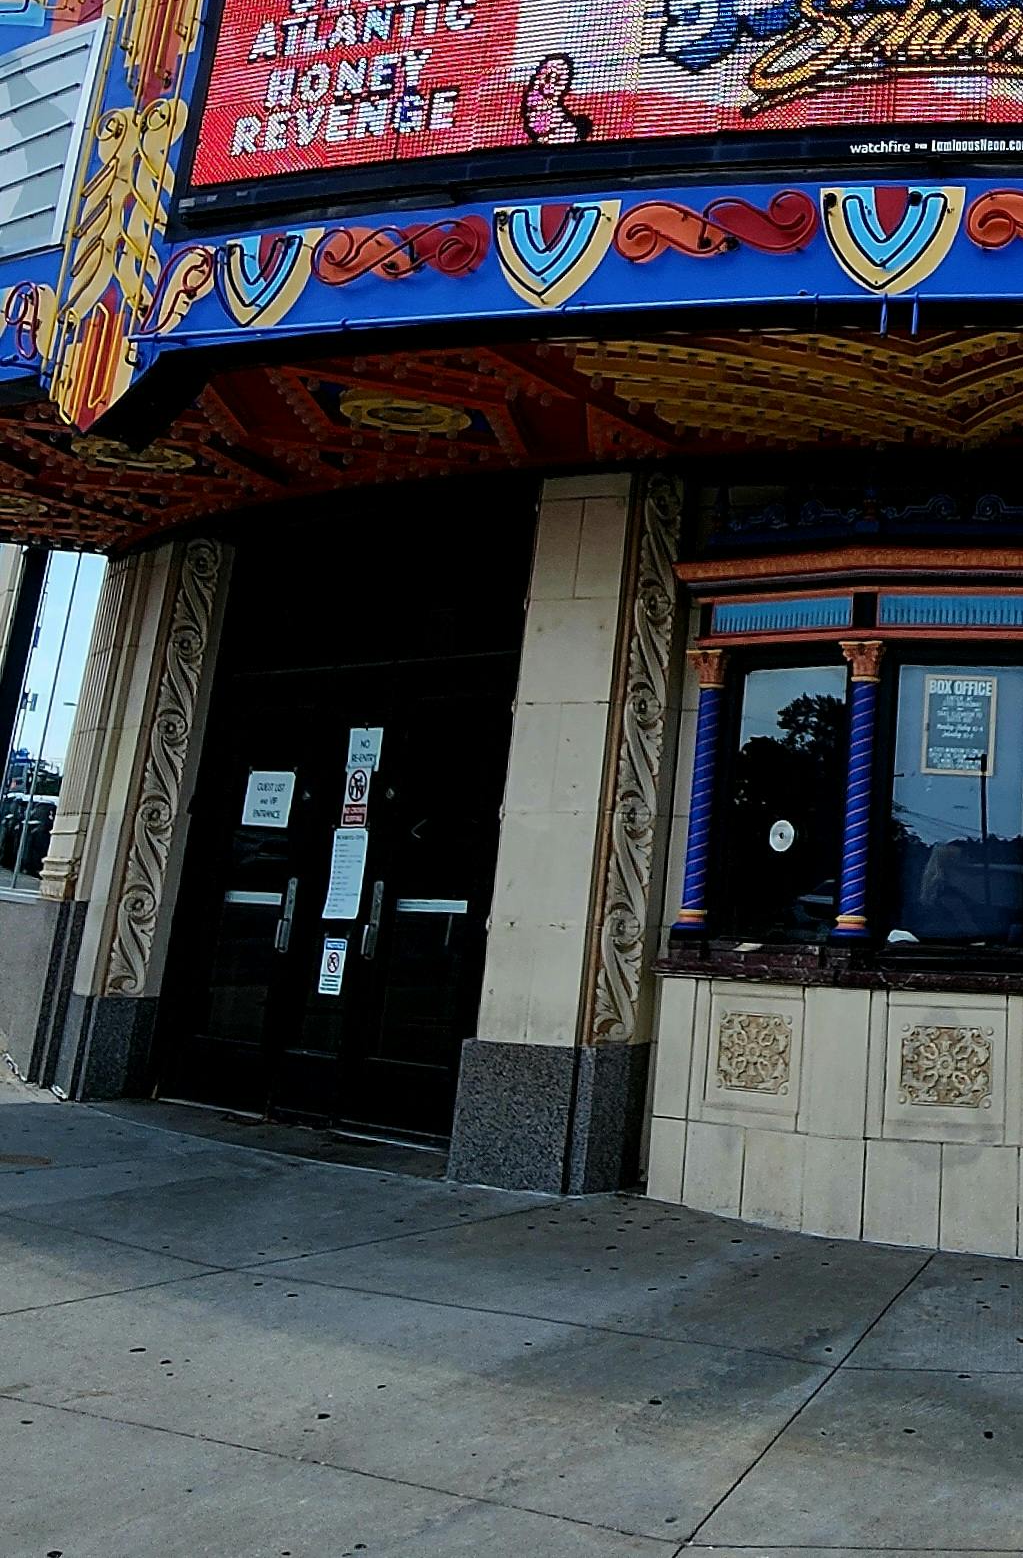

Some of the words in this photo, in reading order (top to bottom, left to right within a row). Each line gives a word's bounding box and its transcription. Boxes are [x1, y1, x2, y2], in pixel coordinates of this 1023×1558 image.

[265, 48, 434, 112] HONEY
[229, 89, 460, 159] REVENGE
[850, 140, 911, 153] watchfire
[928, 679, 953, 694] BOX
[954, 680, 993, 697] OFFICE
